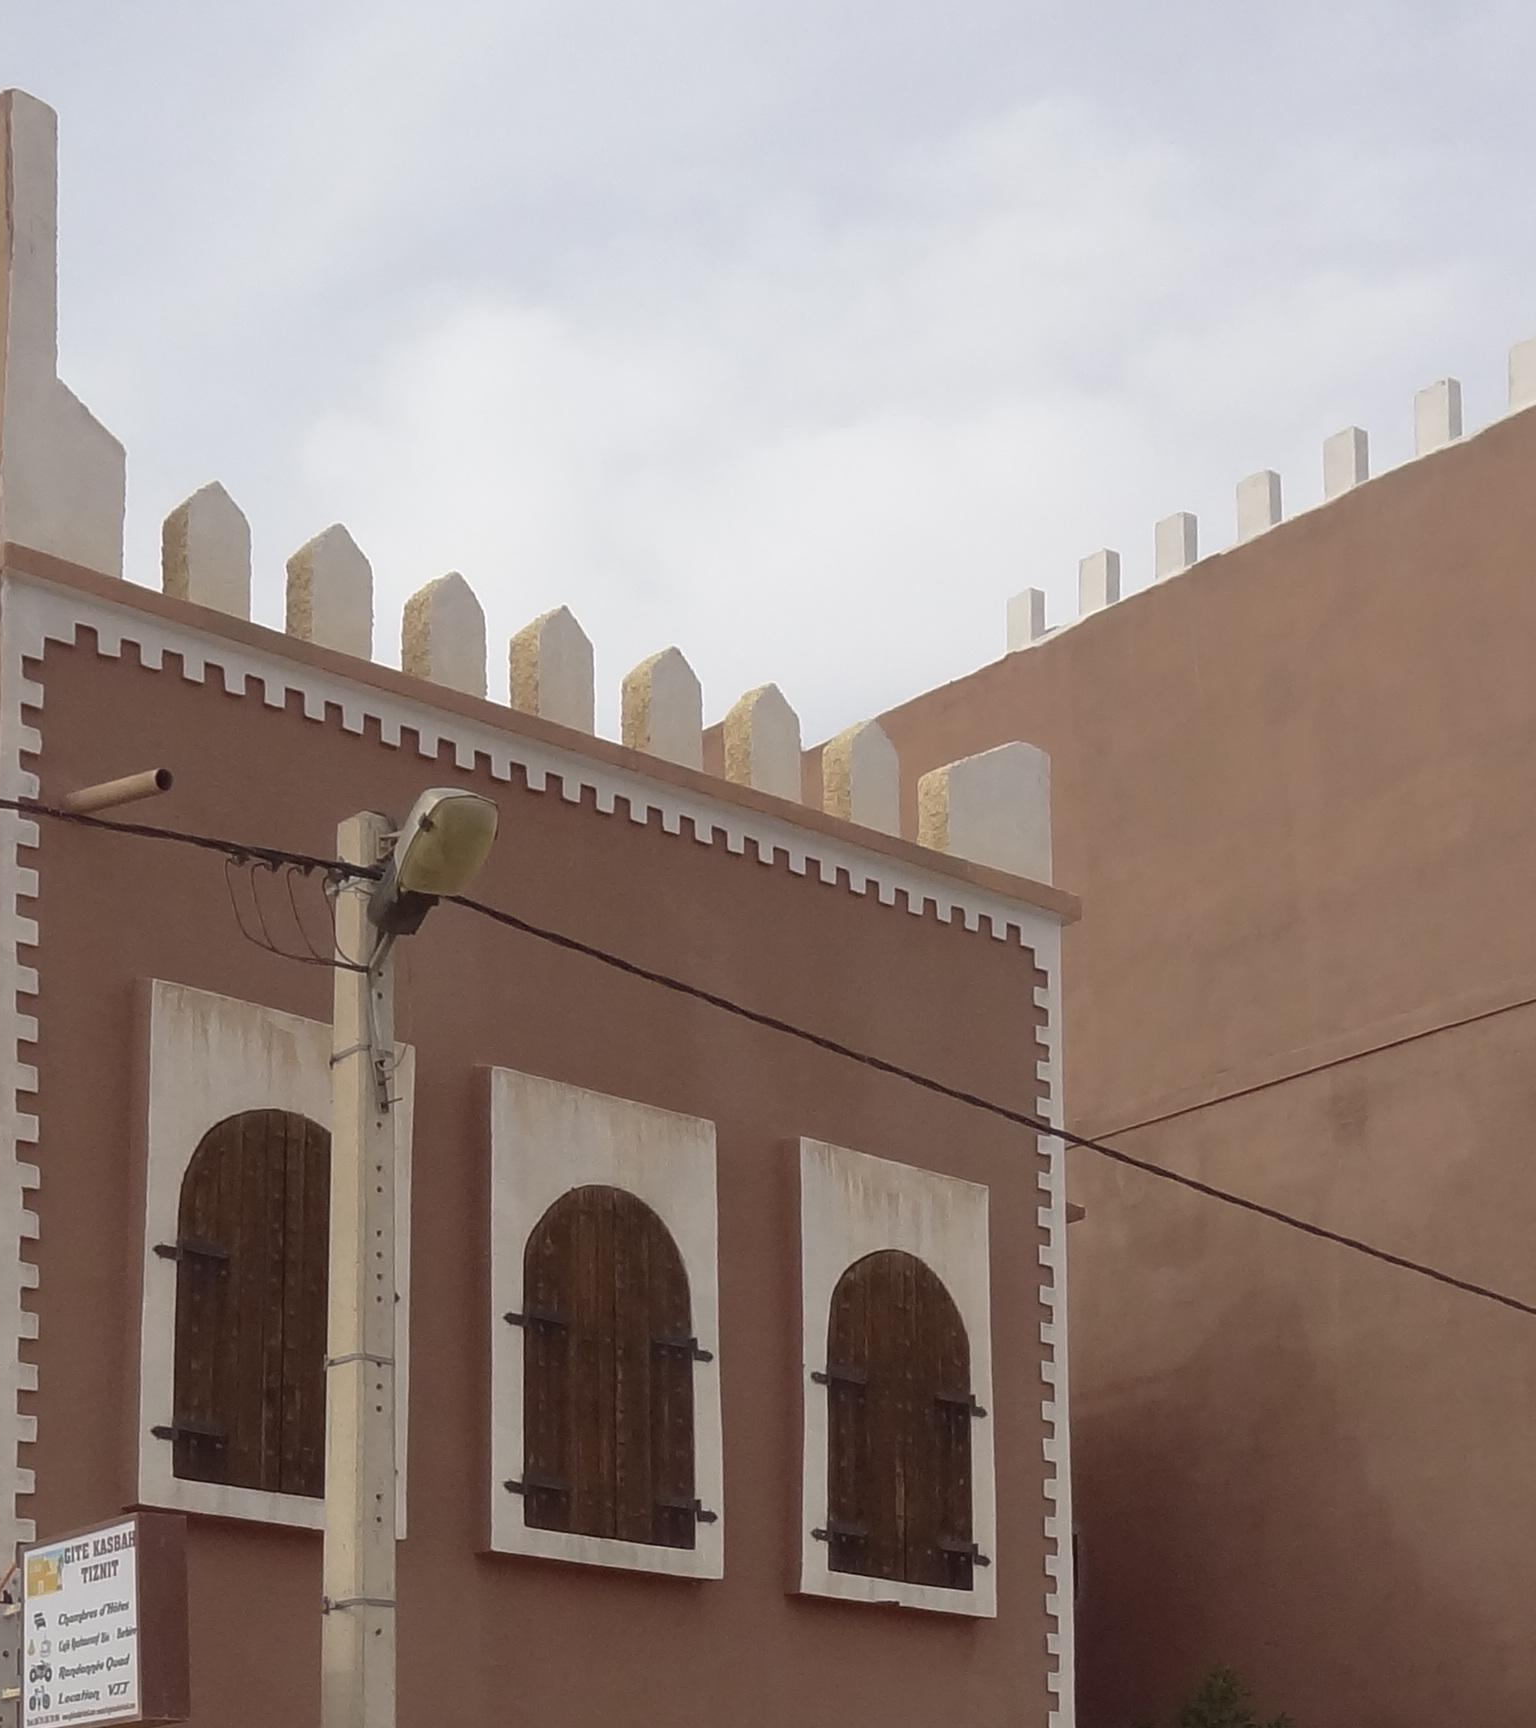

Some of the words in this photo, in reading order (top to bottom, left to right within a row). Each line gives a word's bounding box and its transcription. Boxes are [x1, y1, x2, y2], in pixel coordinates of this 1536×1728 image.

[64, 1543, 89, 1564] GITE
[93, 1530, 136, 1557] KASBAH
[81, 1559, 119, 1584] TIZNIT
[58, 1609, 98, 1627] Chambres
[106, 1653, 130, 1672] Quad
[58, 1689, 100, 1705] Location
[108, 1681, 130, 1696] VTT
